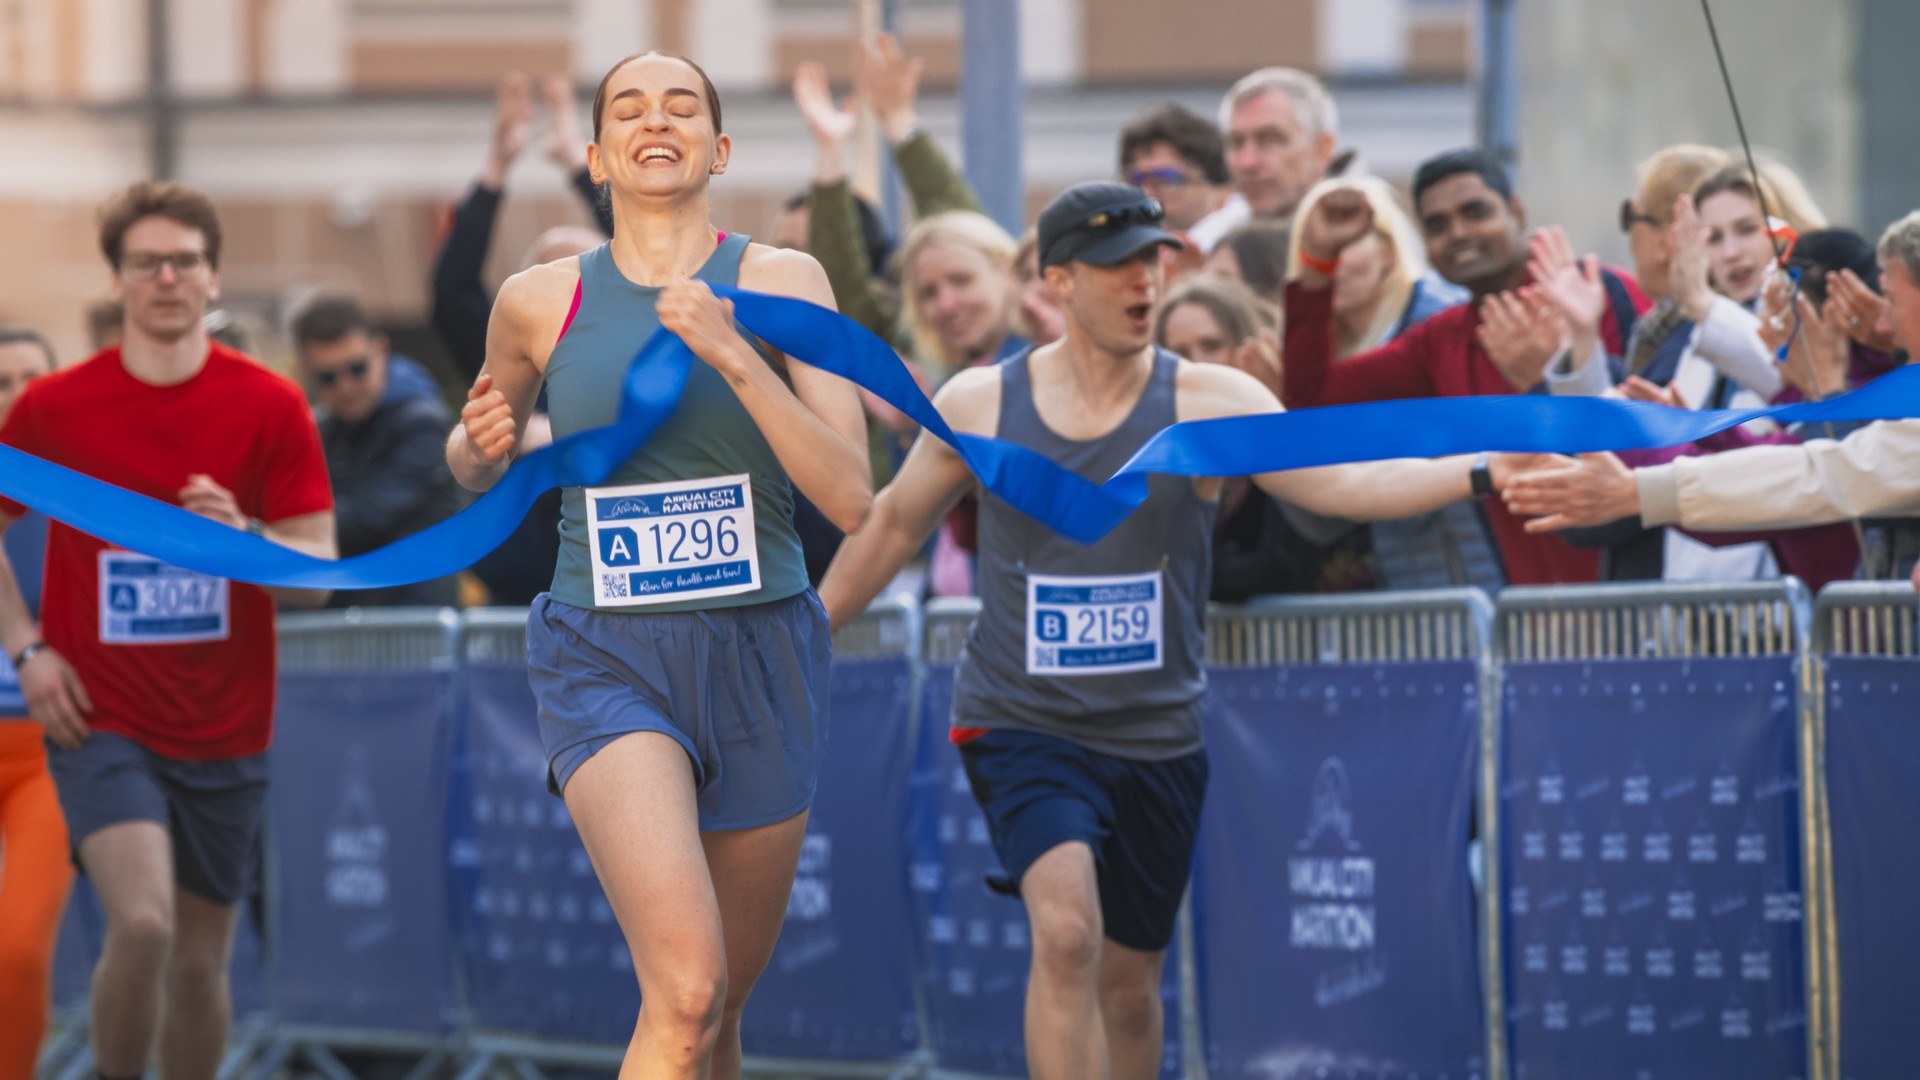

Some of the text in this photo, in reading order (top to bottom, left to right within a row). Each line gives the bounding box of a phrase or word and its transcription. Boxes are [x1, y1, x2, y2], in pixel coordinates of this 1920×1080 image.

[662, 496, 736, 514] MARATHON
[663, 488, 735, 504] ANNUAL CITY
[609, 515, 739, 564] A 1296
[640, 564, 741, 593] Run for health and fun!
[113, 577, 219, 617] A 3047
[1042, 605, 1150, 643] B 2159
